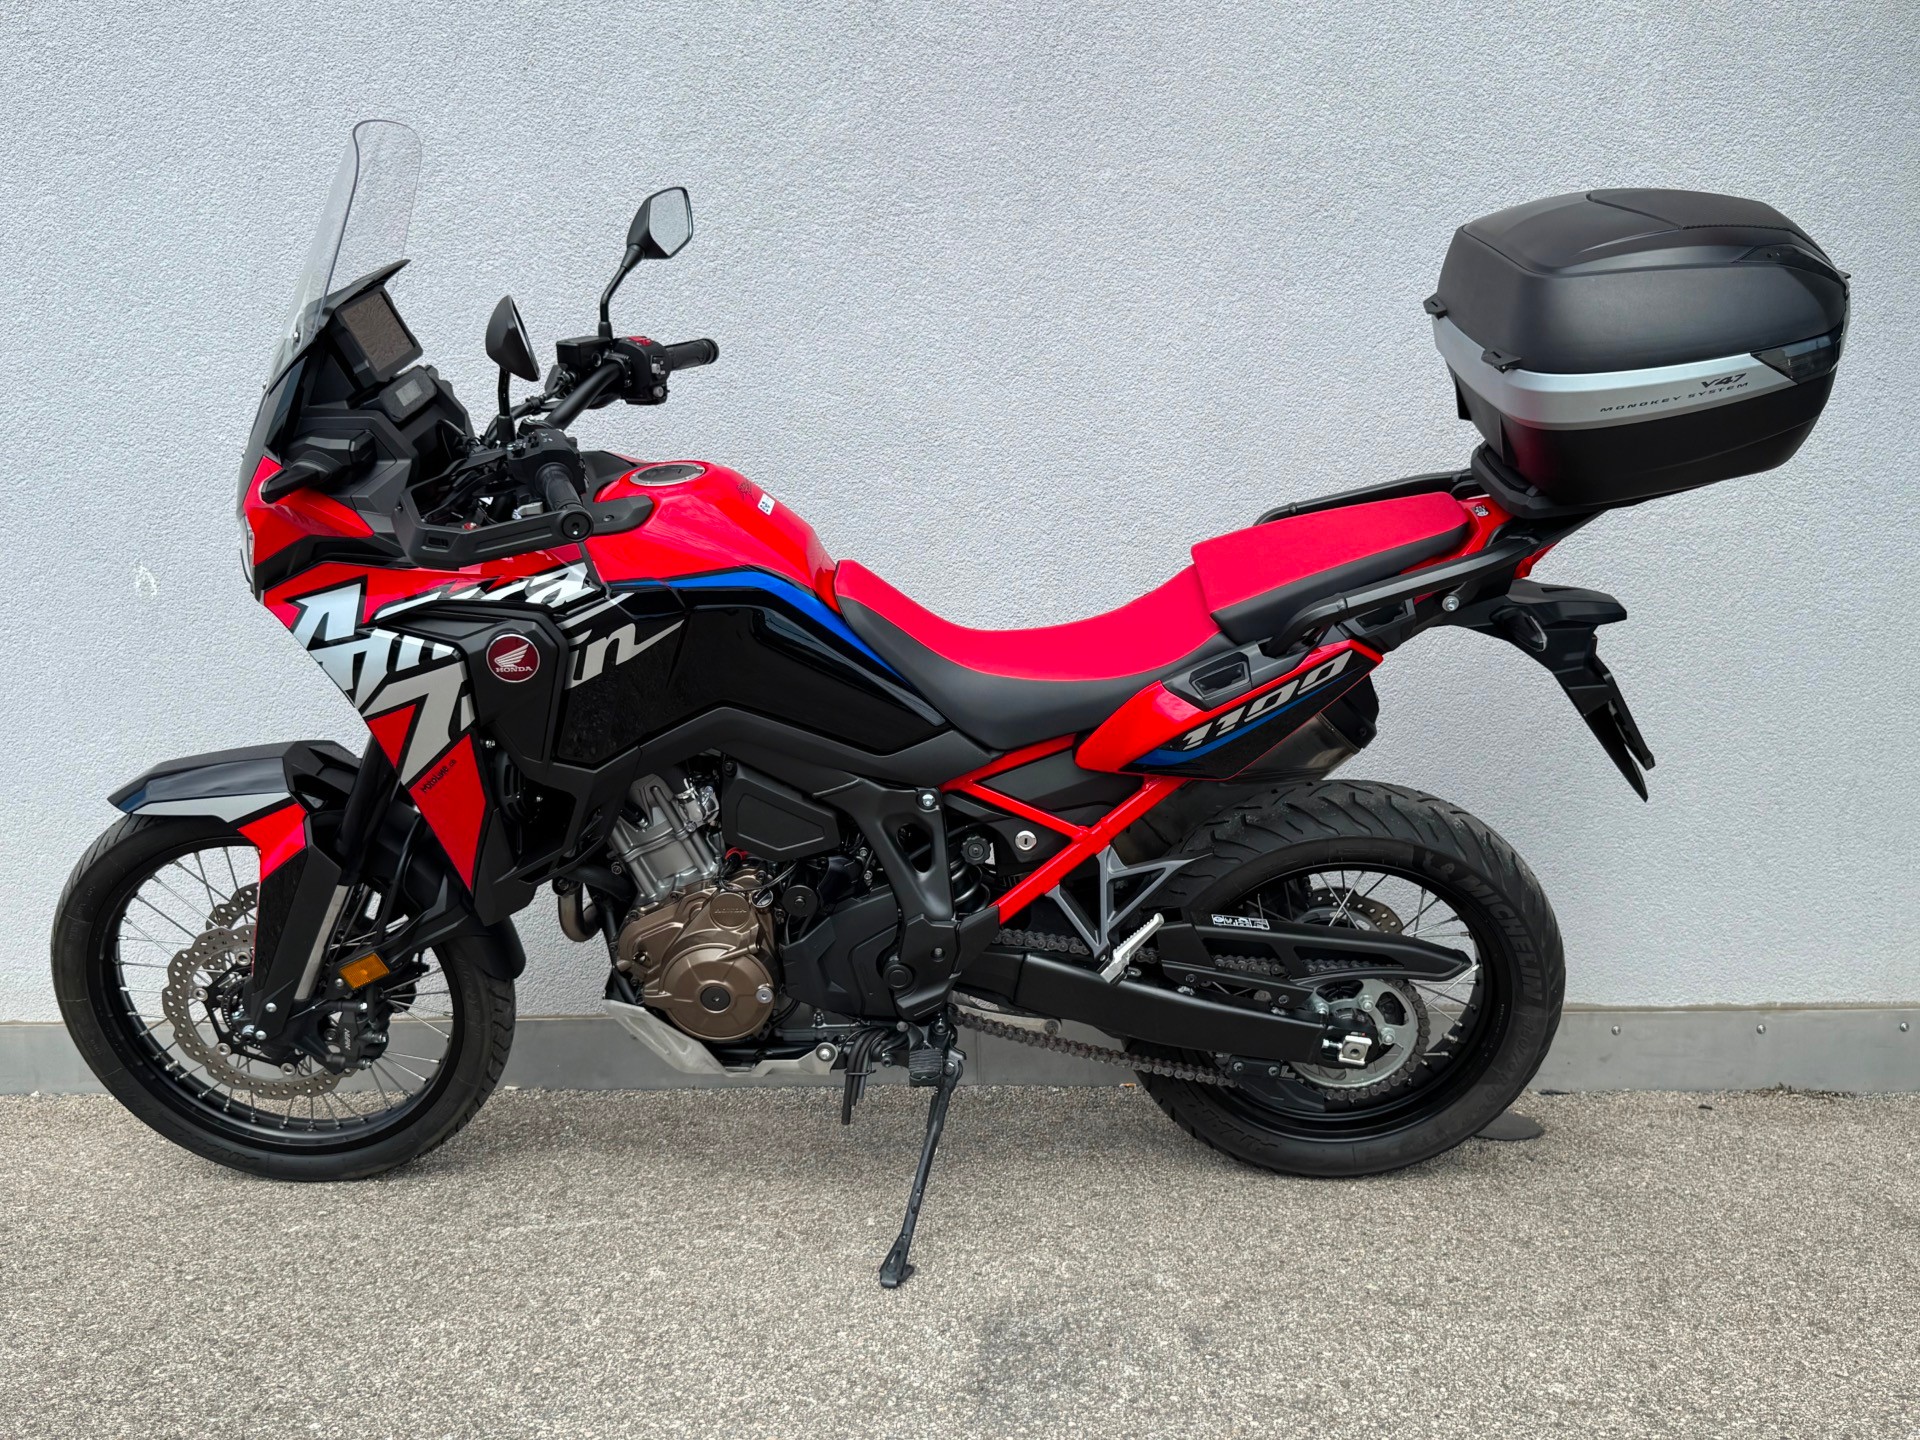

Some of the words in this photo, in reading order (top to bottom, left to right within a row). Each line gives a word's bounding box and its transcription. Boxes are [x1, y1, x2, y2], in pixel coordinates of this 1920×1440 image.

[1600, 395, 1682, 413] MONOKEY
[1688, 382, 1748, 399] SYSTEM
[1701, 373, 1747, 388] V47
[1182, 650, 1353, 751] 1100
[1454, 874, 1544, 1001] MICHELIN
